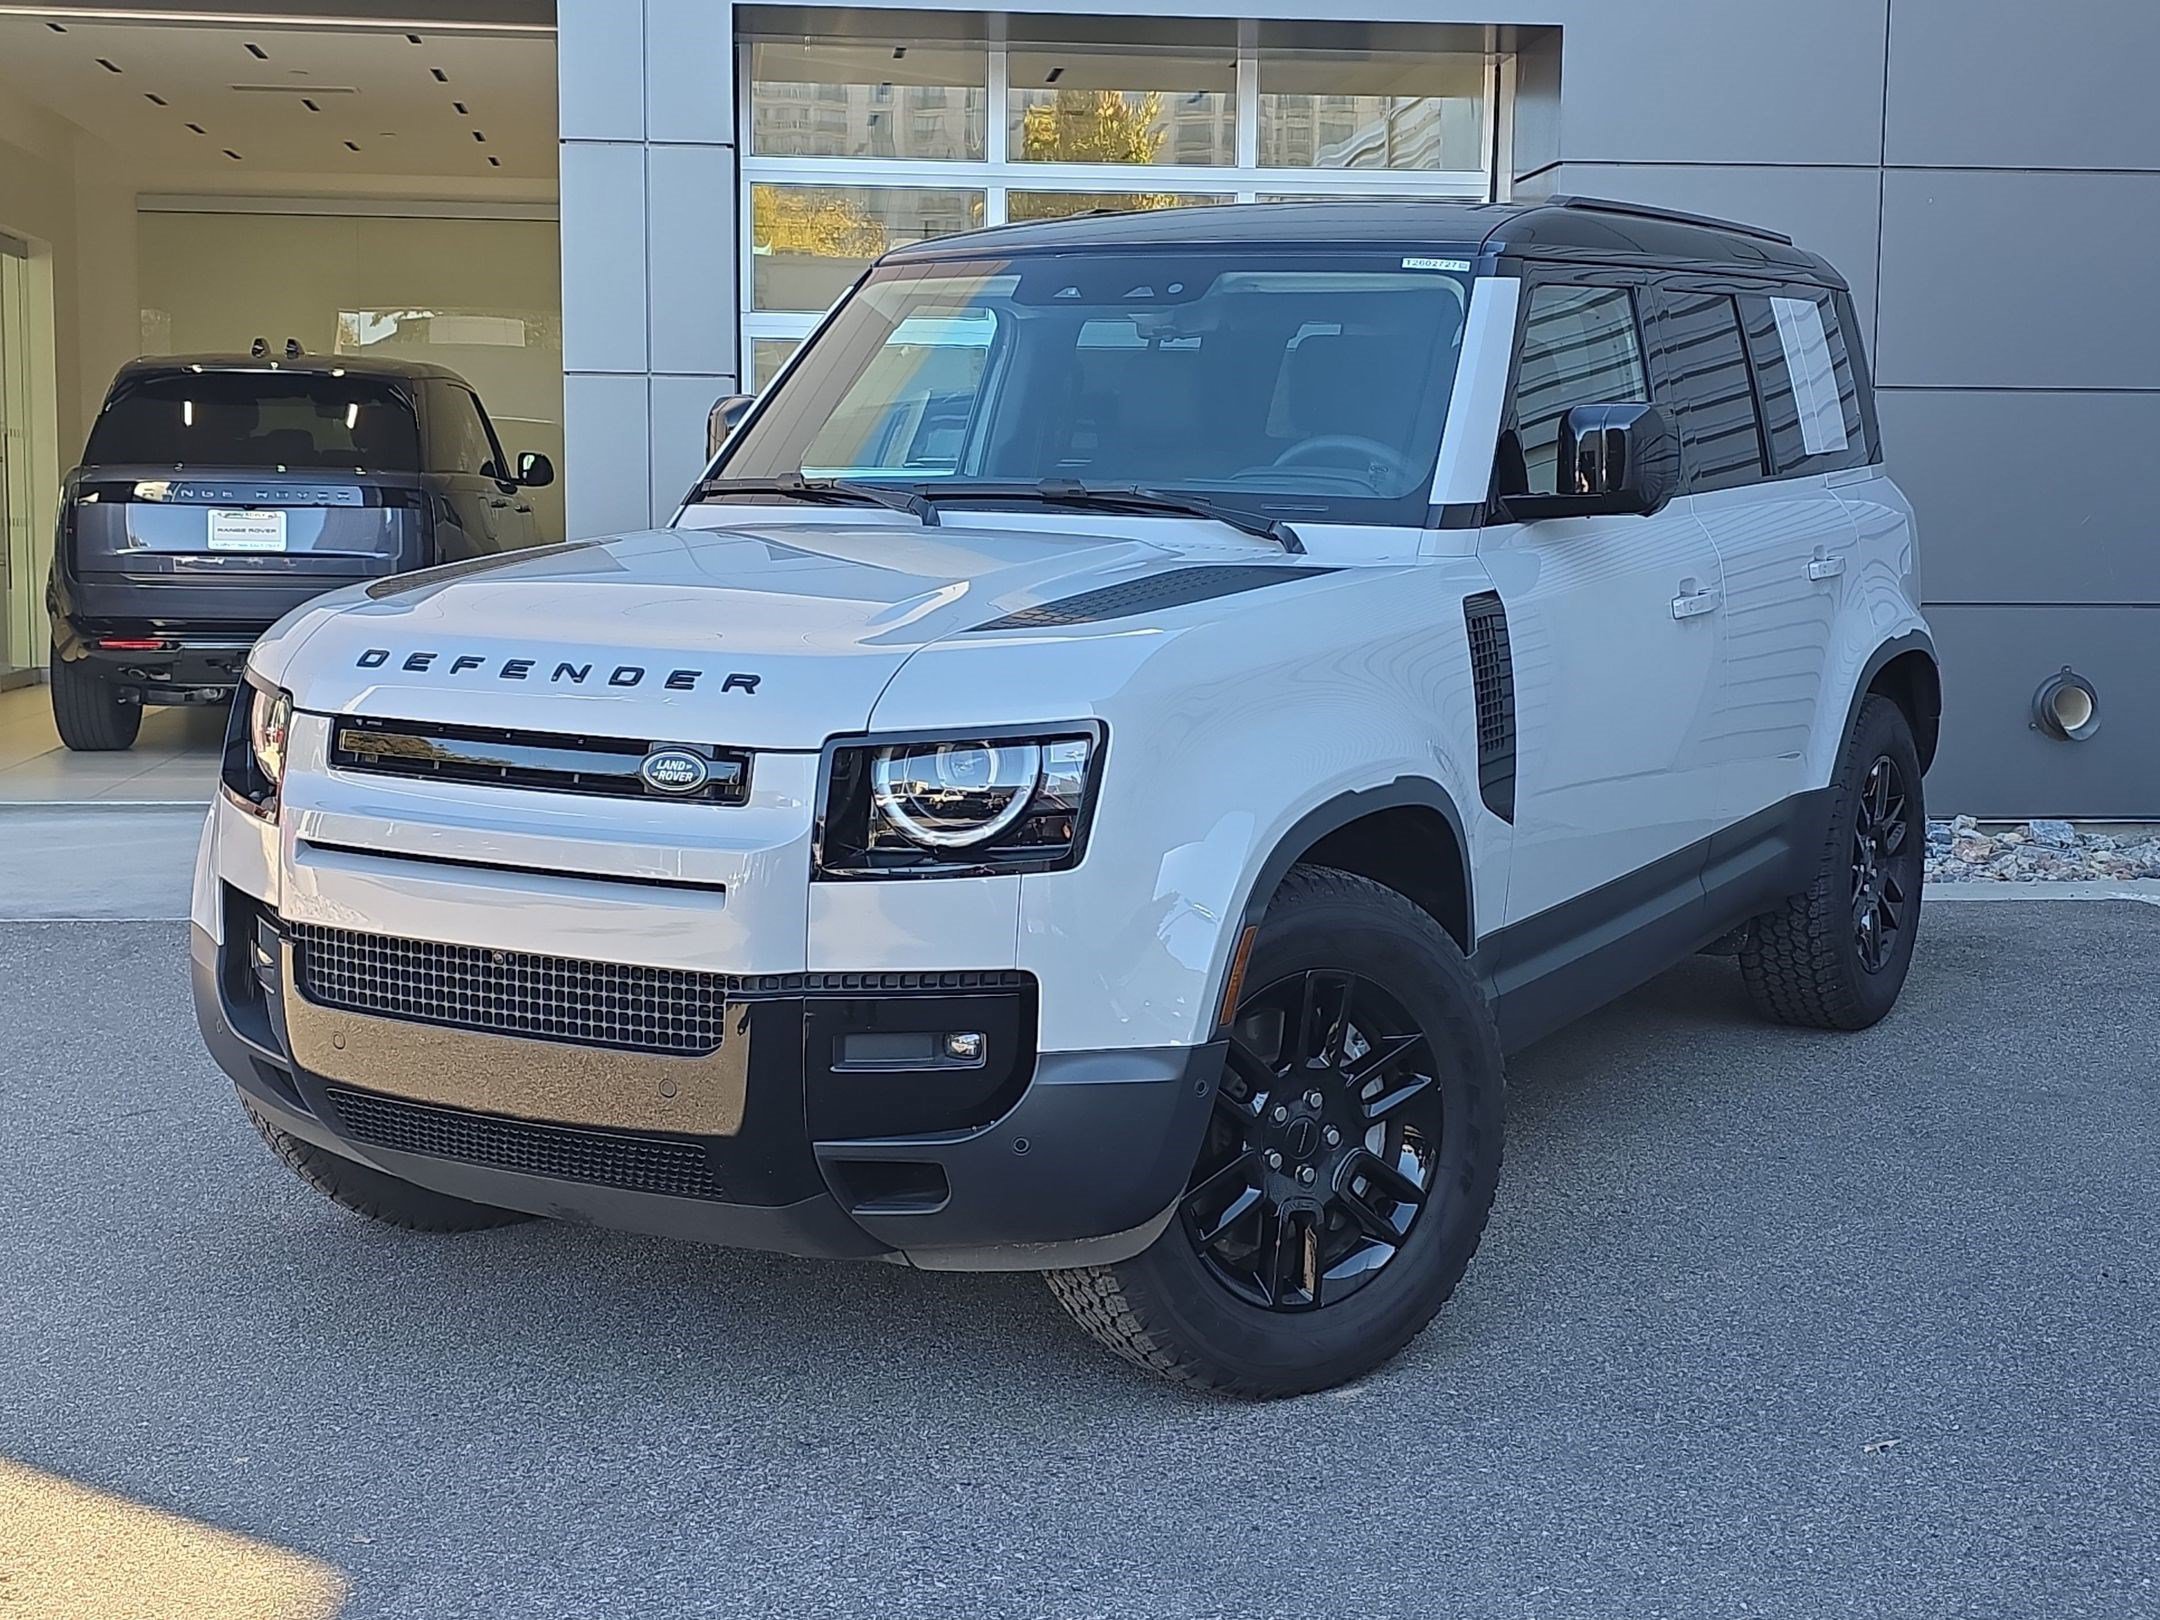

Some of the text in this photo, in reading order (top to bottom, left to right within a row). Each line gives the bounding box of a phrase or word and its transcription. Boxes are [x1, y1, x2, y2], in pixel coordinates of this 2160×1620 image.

[355, 649, 762, 695] DEFENDER
[656, 759, 686, 770] LAND
[657, 770, 694, 782] ROVER
